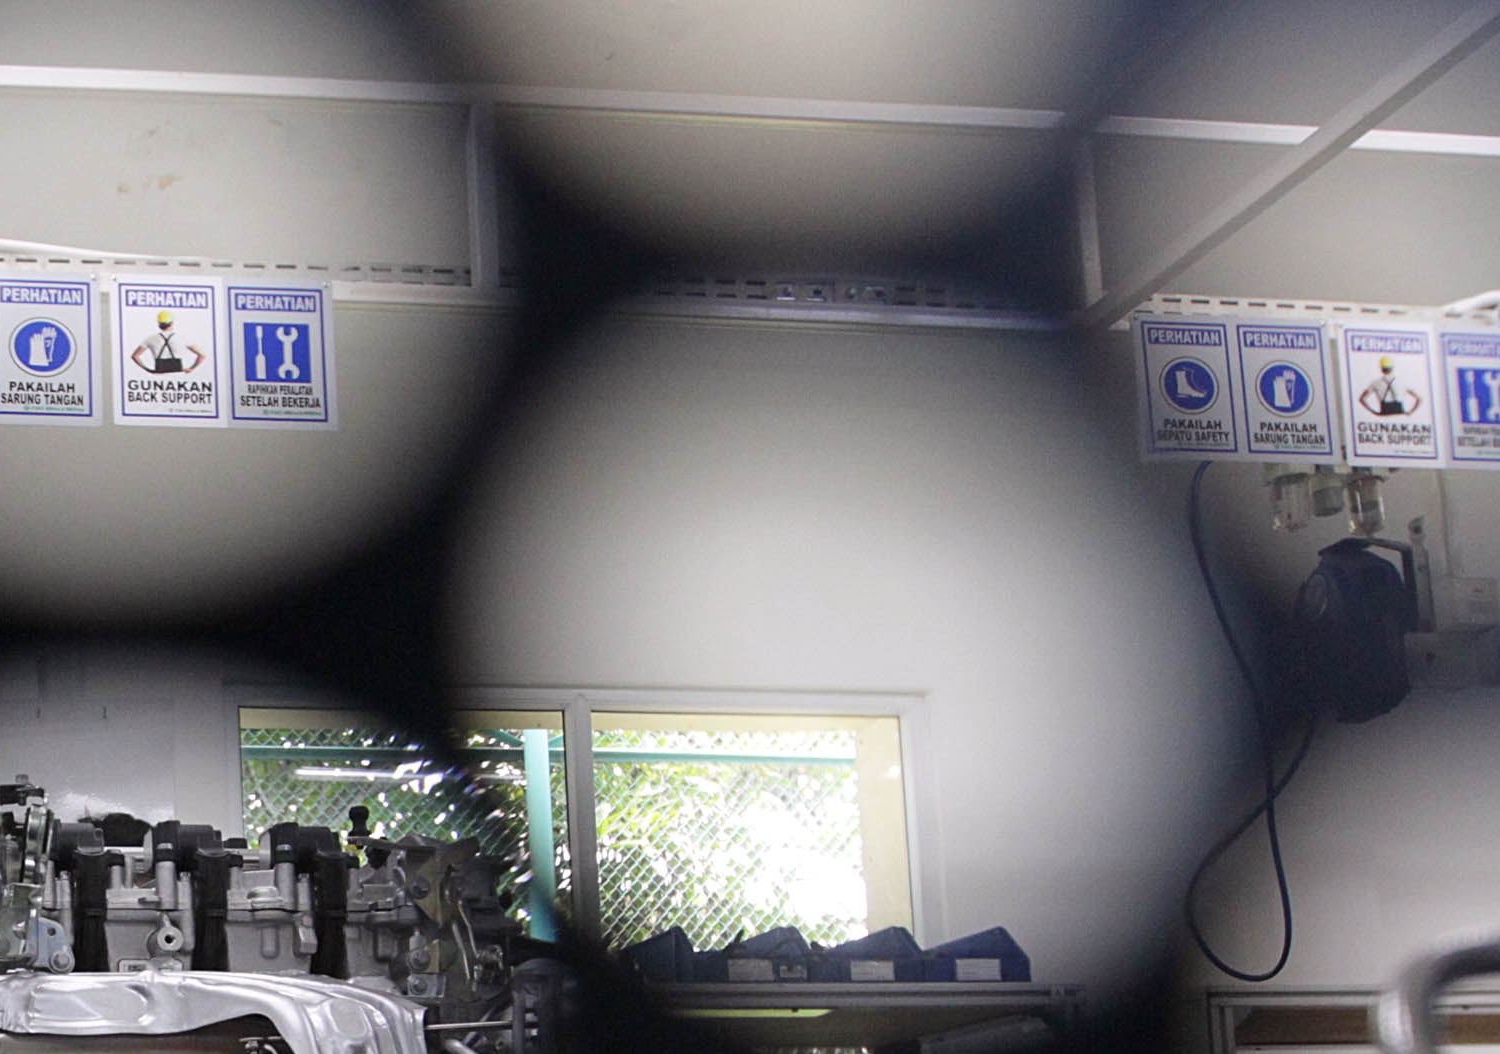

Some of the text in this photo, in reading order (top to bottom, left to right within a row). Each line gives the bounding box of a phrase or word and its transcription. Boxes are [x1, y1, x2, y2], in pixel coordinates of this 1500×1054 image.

[2, 287, 82, 304] PERHATIAN
[128, 291, 206, 307] PERHATIAN
[237, 295, 316, 311] PERHATIAN
[1150, 329, 1220, 345] PERHATIAN
[1246, 332, 1315, 348] PERHATIAN
[9, 381, 75, 393] PAKAILAH
[128, 380, 212, 392] GUNAKAN
[1, 393, 84, 406] SARUNG TANGAN
[128, 391, 212, 405] BACK SUPPORT
[240, 395, 321, 409] SETELAH BEKERJA
[1164, 418, 1222, 430] PAKAILAH
[1260, 421, 1317, 433] PAKAILAH
[1357, 422, 1431, 433] GUNAKAN
[1156, 430, 1229, 442] SEPATU SAFETY
[1254, 433, 1325, 445] SARUNG TANGAN
[1358, 433, 1431, 445] BACK SUPPORT
